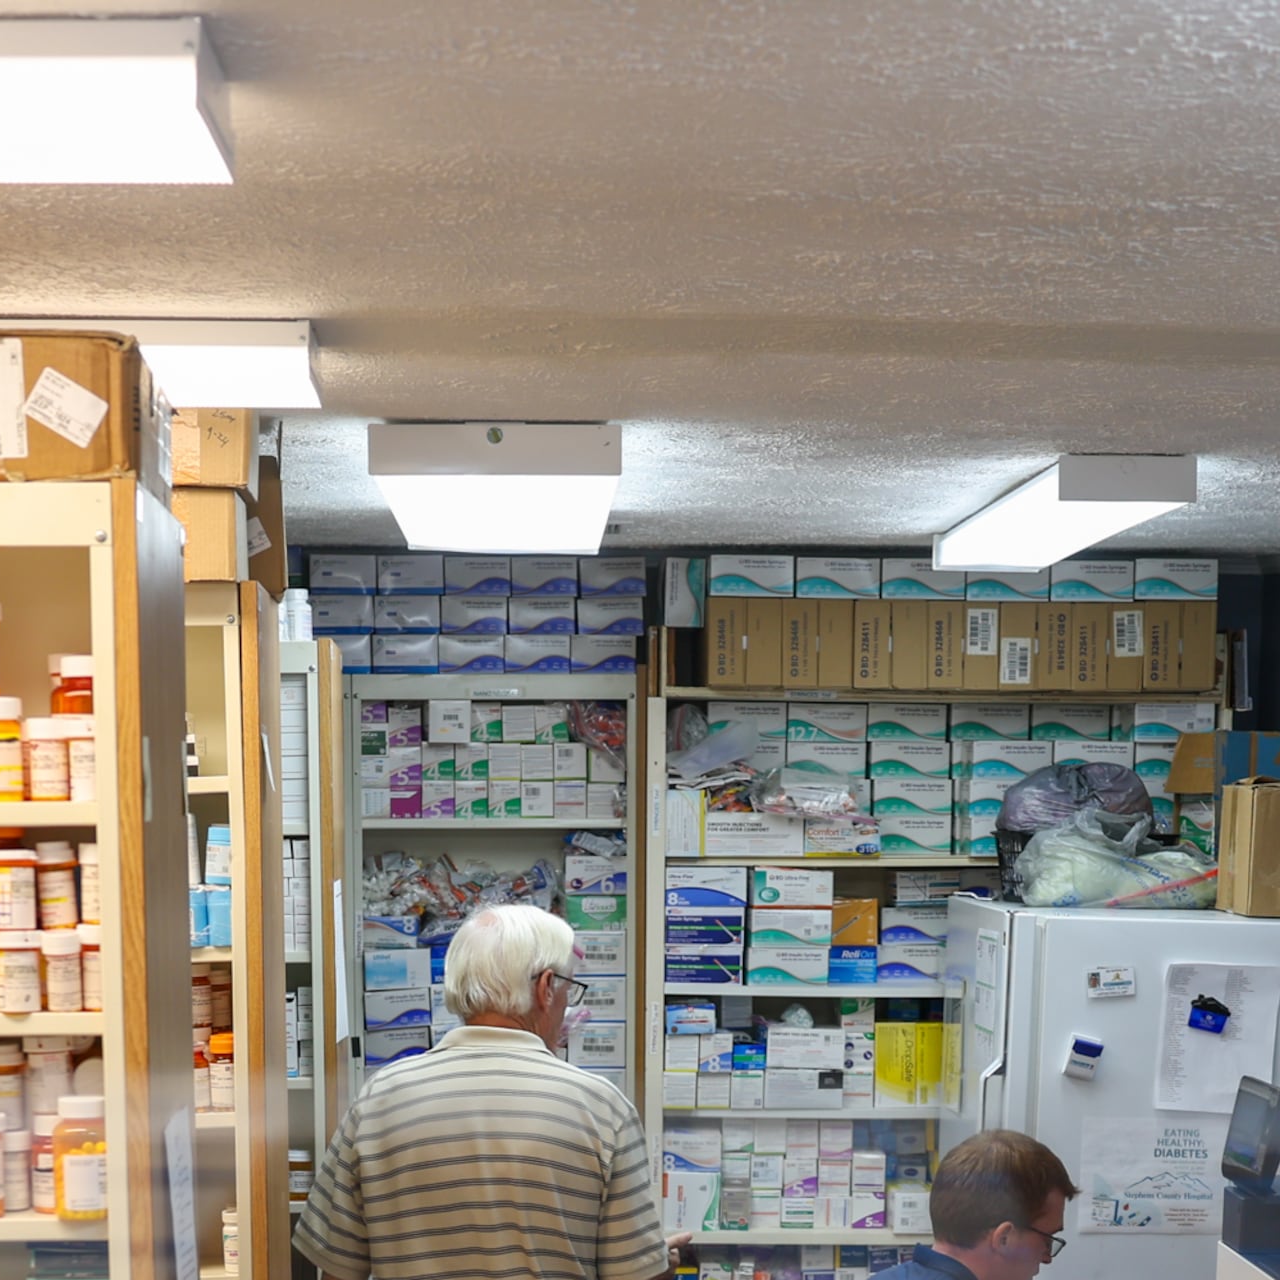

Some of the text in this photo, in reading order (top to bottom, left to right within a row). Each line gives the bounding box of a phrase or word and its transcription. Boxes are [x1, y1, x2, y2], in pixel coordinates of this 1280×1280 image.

[808, 828, 839, 836] Comfort
[601, 877, 615, 894] 6
[668, 892, 678, 905] 8
[842, 950, 874, 959] ReliOn
[708, 1056, 720, 1072] 8
[1164, 1128, 1200, 1137] EATING
[1157, 1138, 1204, 1148] HEALTHY:
[1154, 1149, 1208, 1159] DIABETES
[664, 1155, 675, 1171] 8
[1124, 1192, 1154, 1200] Stephens
[1156, 1192, 1182, 1200] County
[865, 1217, 873, 1227] 5
